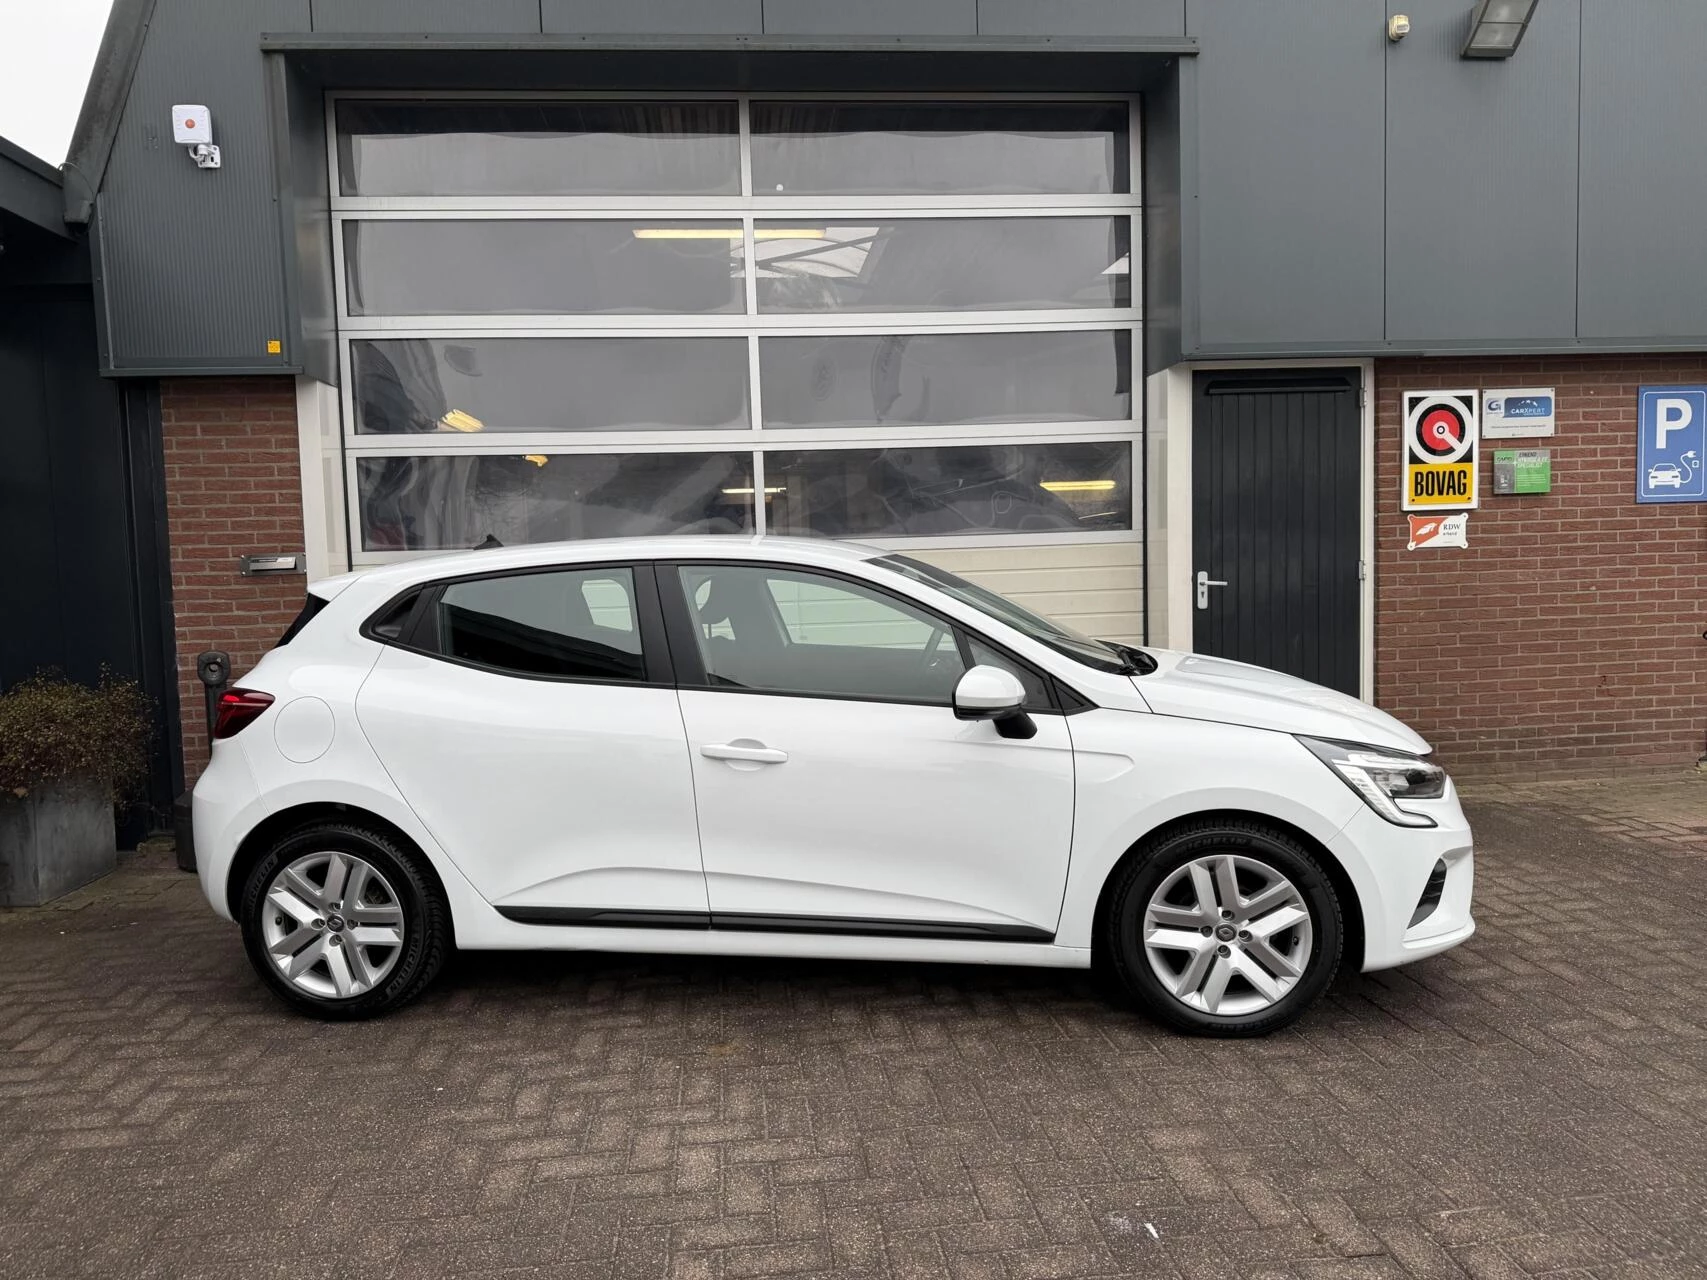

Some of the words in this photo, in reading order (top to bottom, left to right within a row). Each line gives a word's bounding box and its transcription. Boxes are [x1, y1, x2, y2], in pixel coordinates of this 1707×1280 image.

[1656, 398, 1692, 449] P
[1414, 469, 1467, 497] BOVAG
[1443, 523, 1461, 531] RDW
